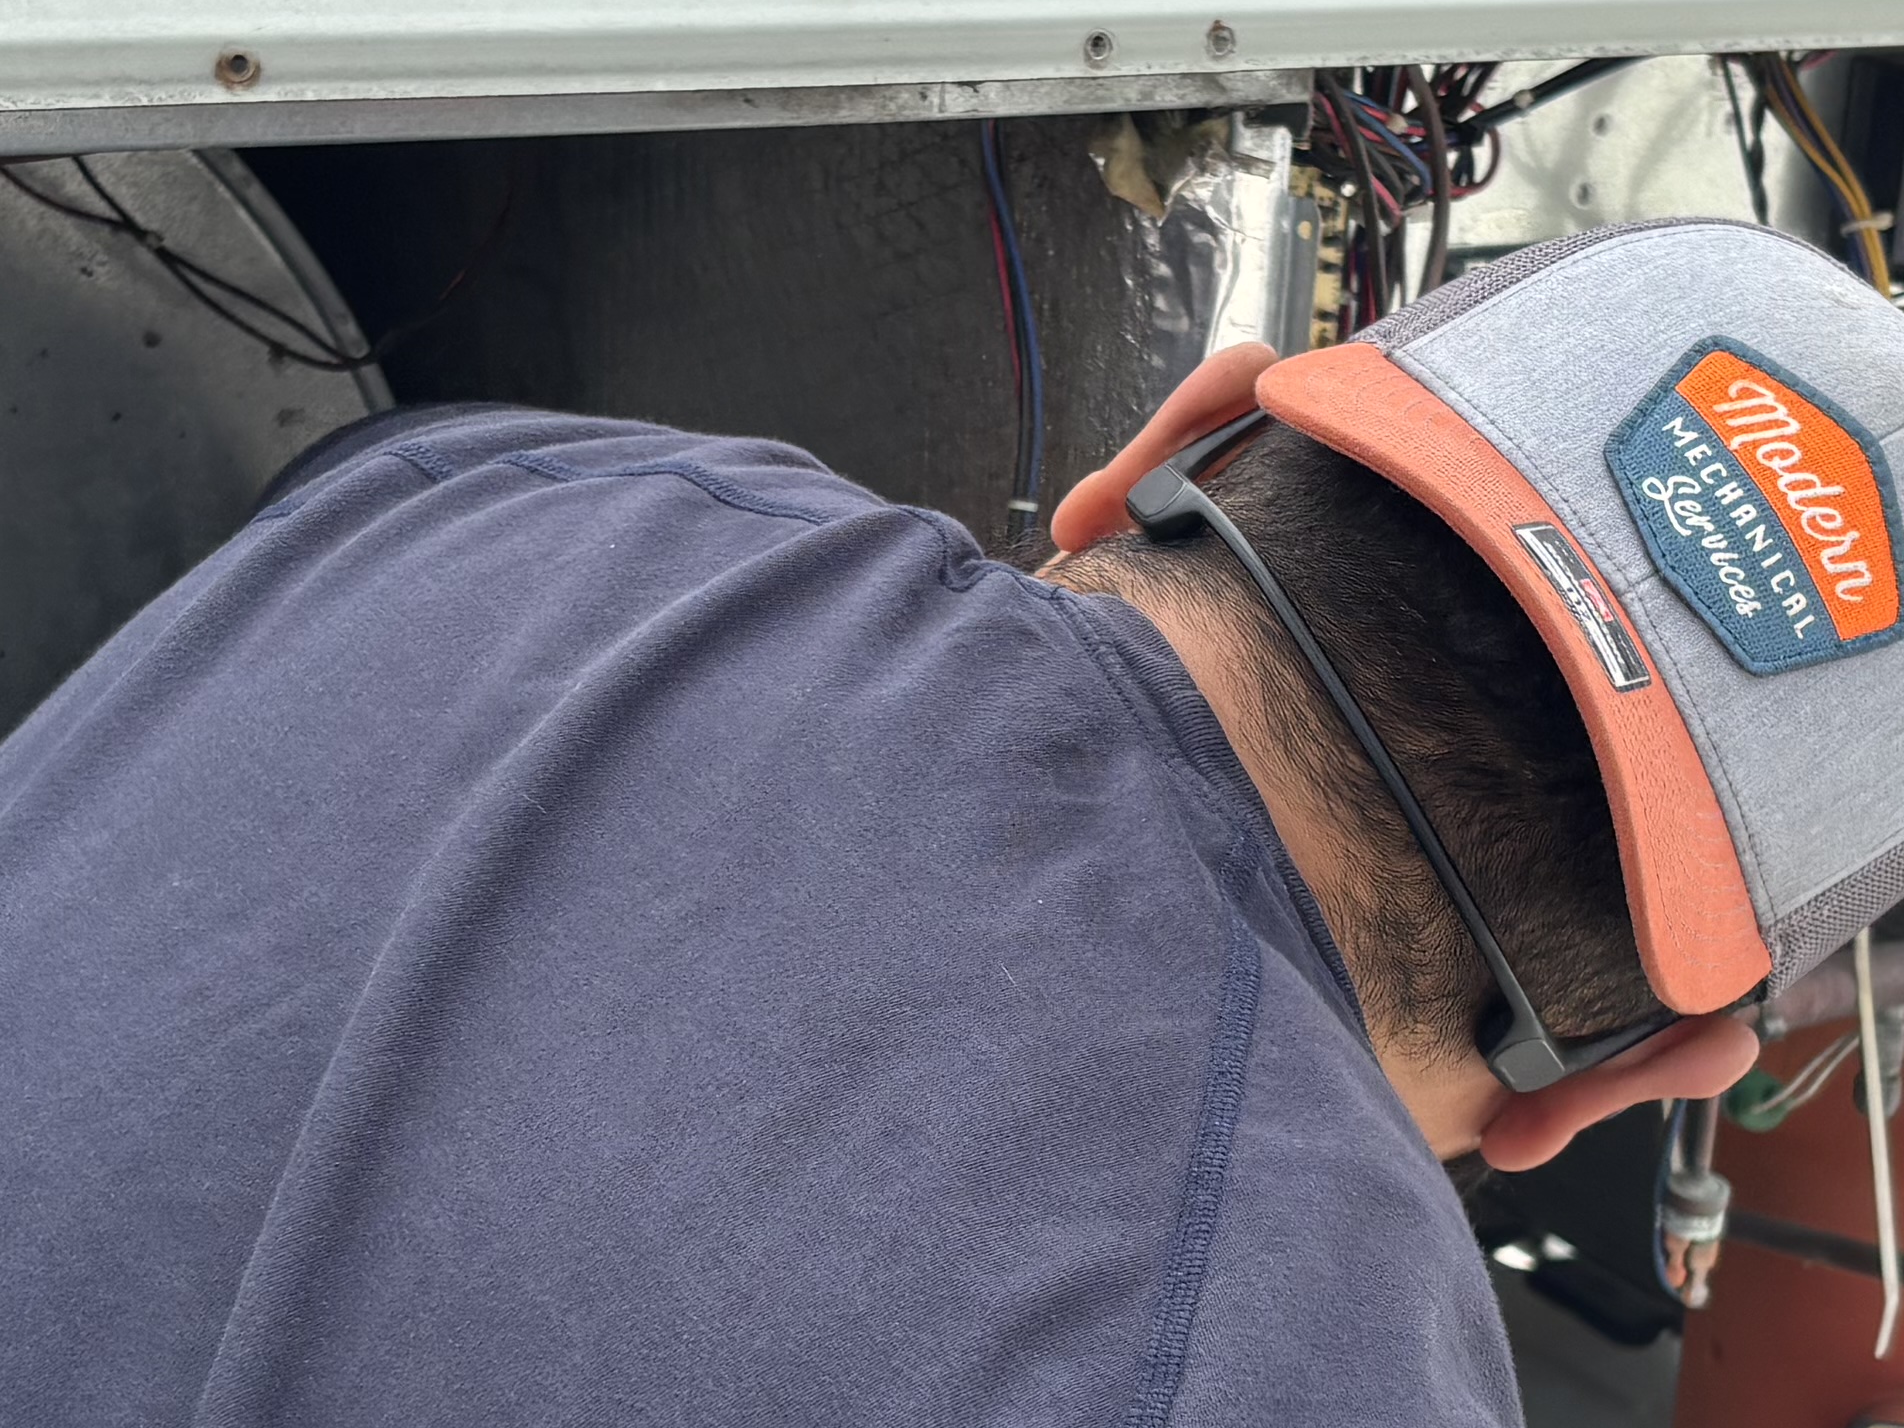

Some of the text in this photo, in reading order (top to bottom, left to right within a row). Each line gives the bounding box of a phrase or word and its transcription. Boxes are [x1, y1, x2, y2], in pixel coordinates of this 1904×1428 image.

[1642, 475, 1762, 619] Services
[1662, 416, 1814, 639] MECHANICAL
[1712, 378, 1873, 603] Modern
